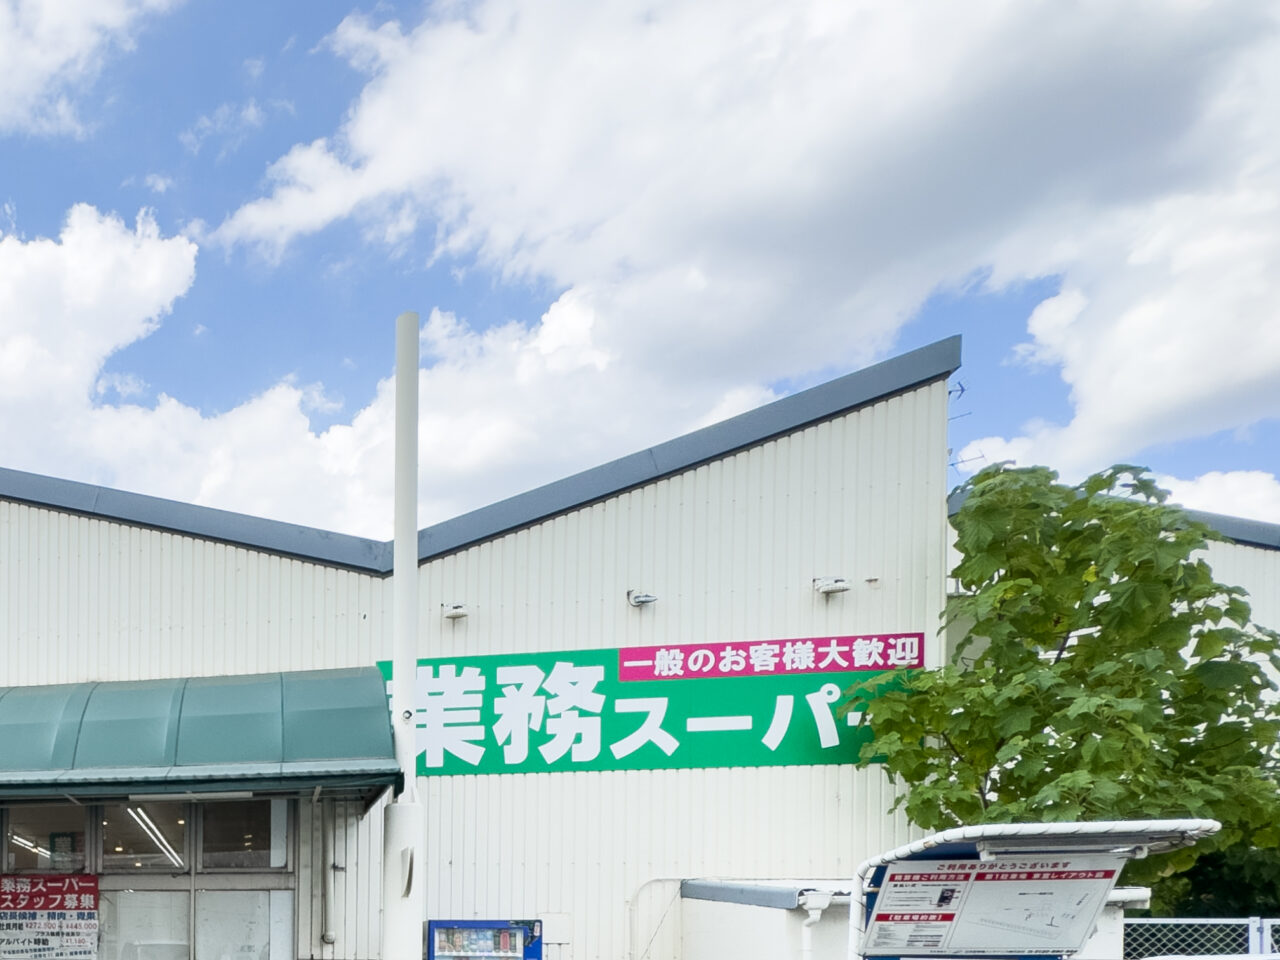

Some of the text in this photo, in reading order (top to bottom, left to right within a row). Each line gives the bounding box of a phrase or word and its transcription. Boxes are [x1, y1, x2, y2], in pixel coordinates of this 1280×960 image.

[623, 637, 920, 677] 一般のお客様大歓迎
[937, 862, 1071, 871] ご利用ありがとうございます
[0, 878, 95, 893] 業務スーパー
[0, 894, 94, 909] スタッフ募集
[0, 911, 96, 921] 店長候補・精肉・青果
[0, 938, 49, 946] アルバイト時給
